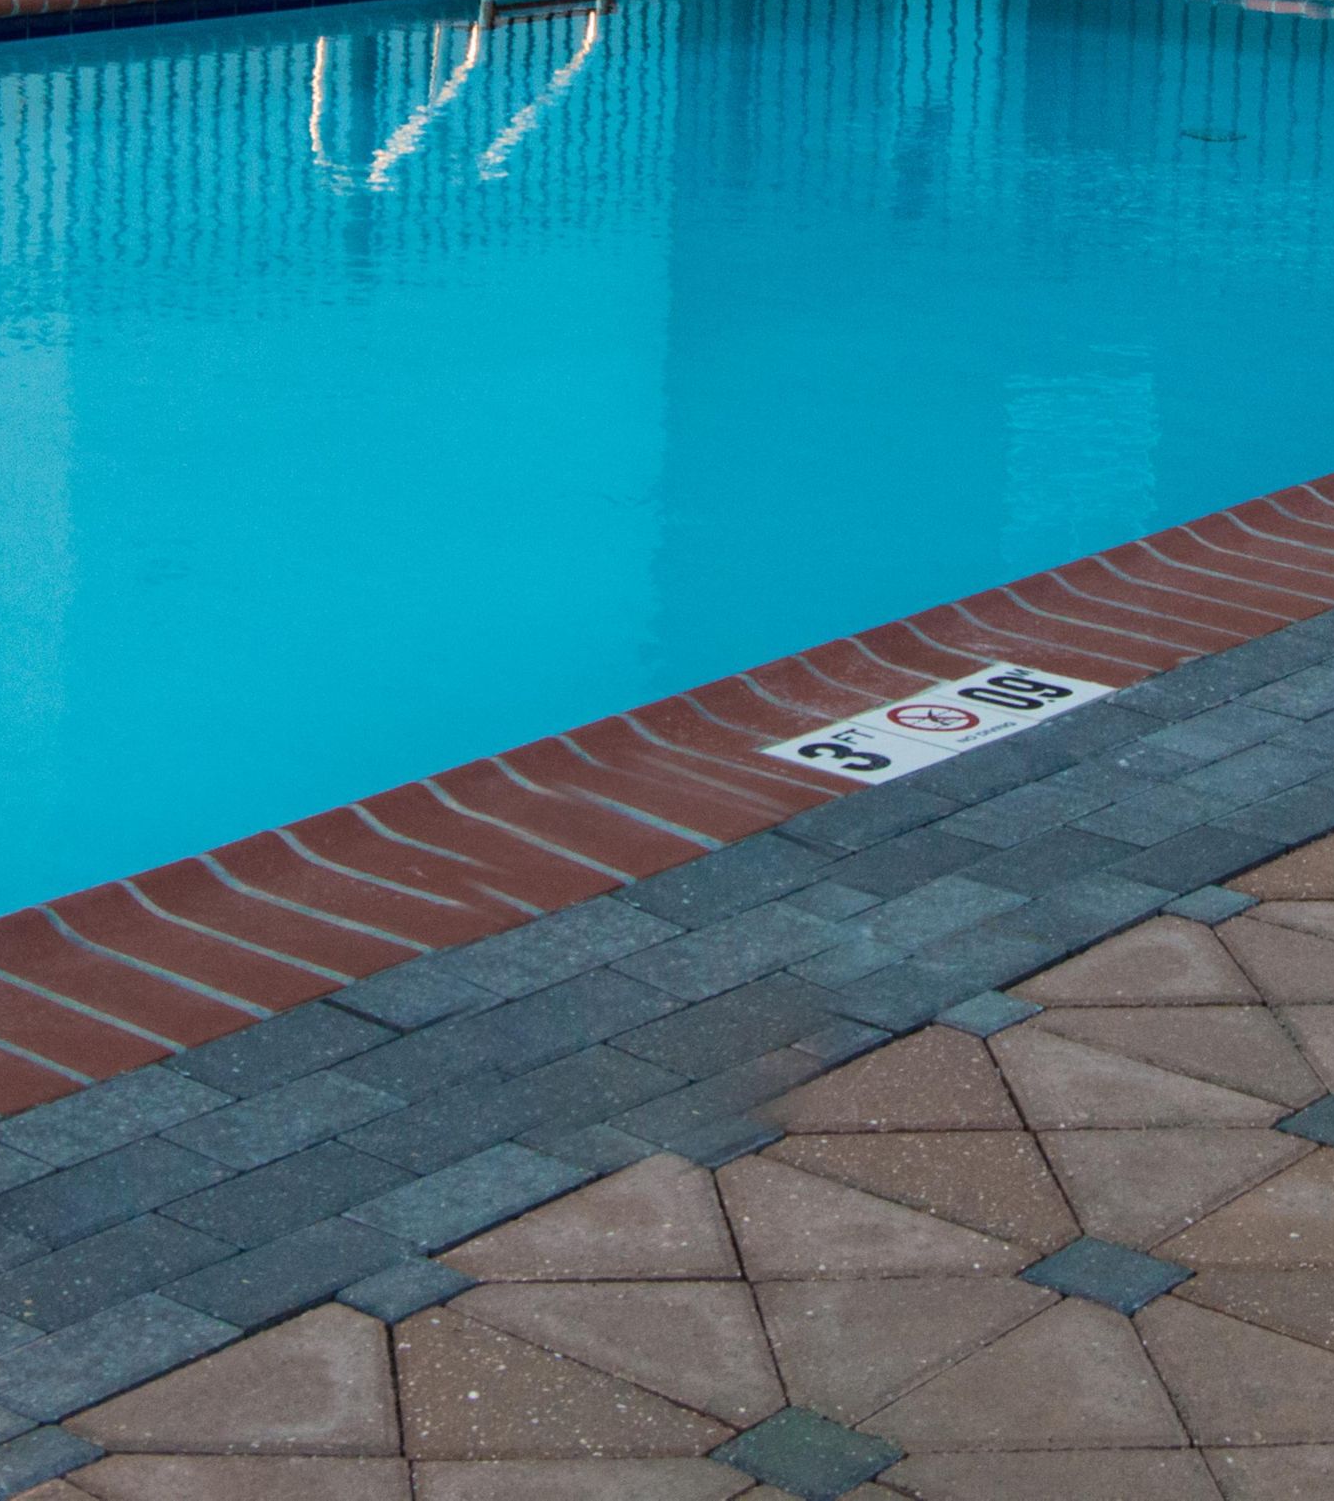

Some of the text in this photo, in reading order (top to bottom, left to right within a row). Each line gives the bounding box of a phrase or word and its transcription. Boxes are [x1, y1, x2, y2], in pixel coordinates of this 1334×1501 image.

[975, 721, 1018, 737] DIVING
[797, 728, 892, 772] 3 FT
